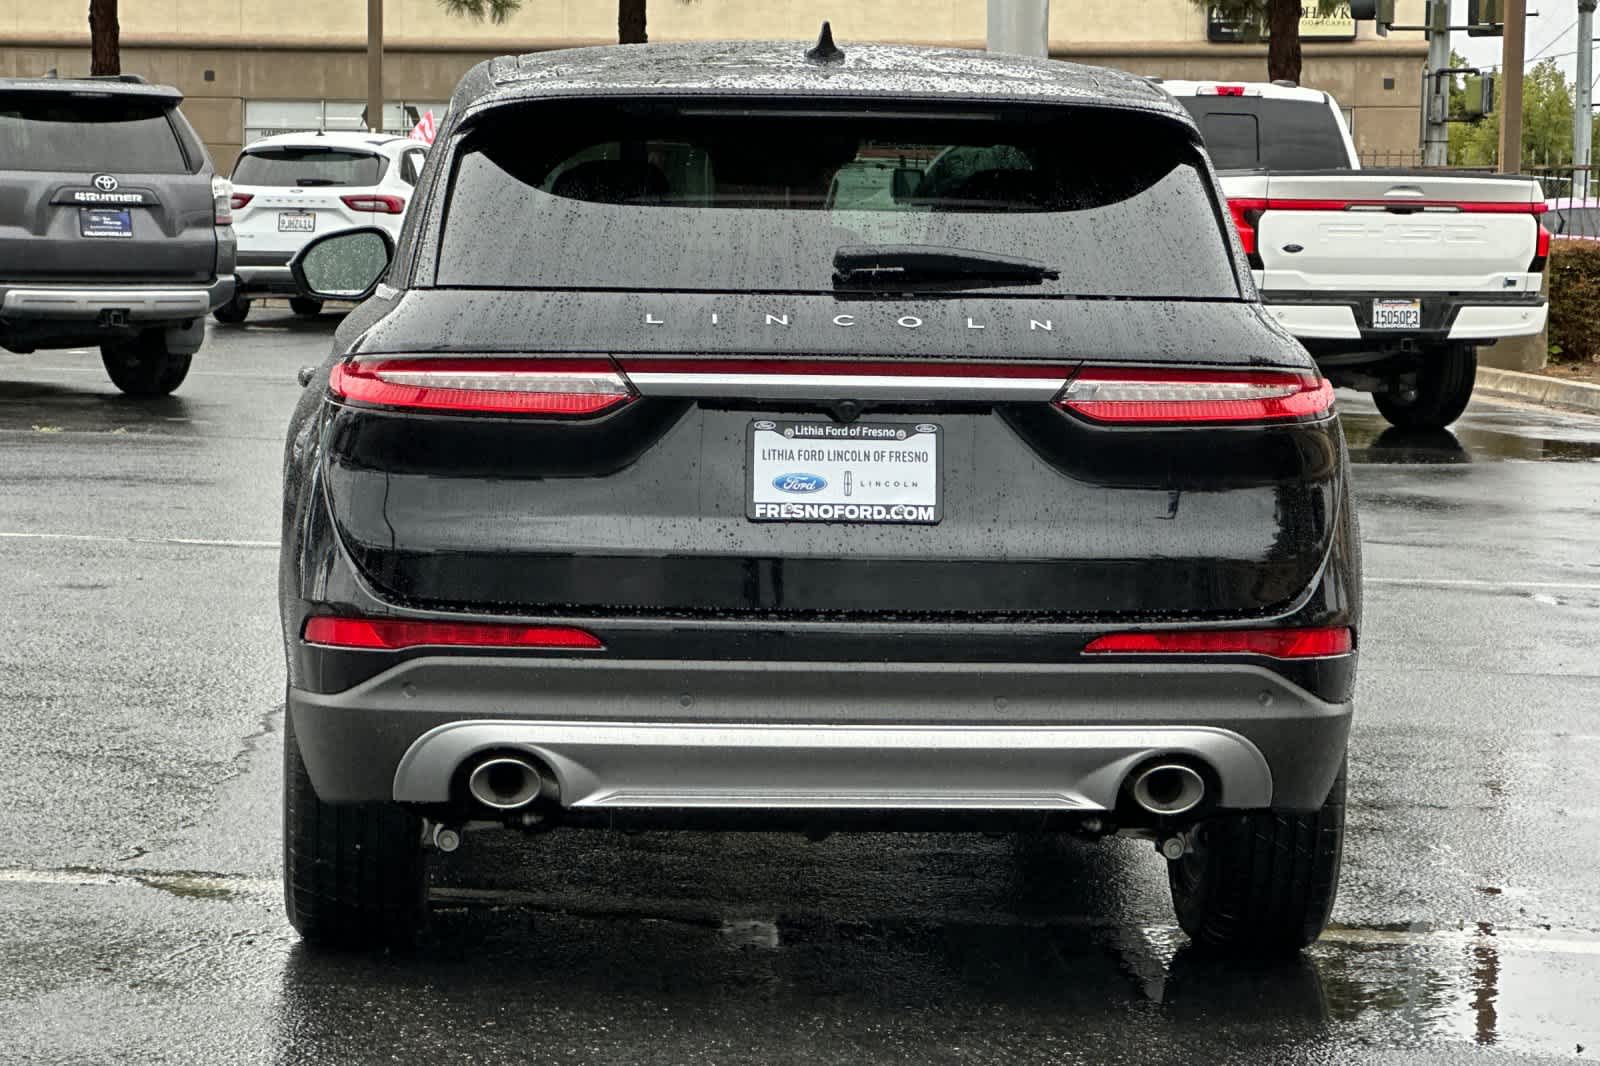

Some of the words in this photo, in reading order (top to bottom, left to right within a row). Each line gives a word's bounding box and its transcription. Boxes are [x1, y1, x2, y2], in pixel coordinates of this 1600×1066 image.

[1300, 6, 1350, 20] HAWK
[645, 313, 1053, 330] LINCOLN
[795, 425, 824, 436] Lithia
[825, 426, 848, 437] Ford
[849, 426, 861, 437] of
[862, 427, 895, 438] Fresno
[762, 448, 795, 462] LITHIA
[797, 449, 825, 462] FORD
[827, 449, 871, 463] LINCOLN
[873, 450, 887, 463] OF
[889, 450, 929, 464] FRESNO
[783, 477, 816, 491] Ford
[860, 480, 918, 488] LINCOLN
[755, 504, 935, 520] FRESNOFORD.COM
